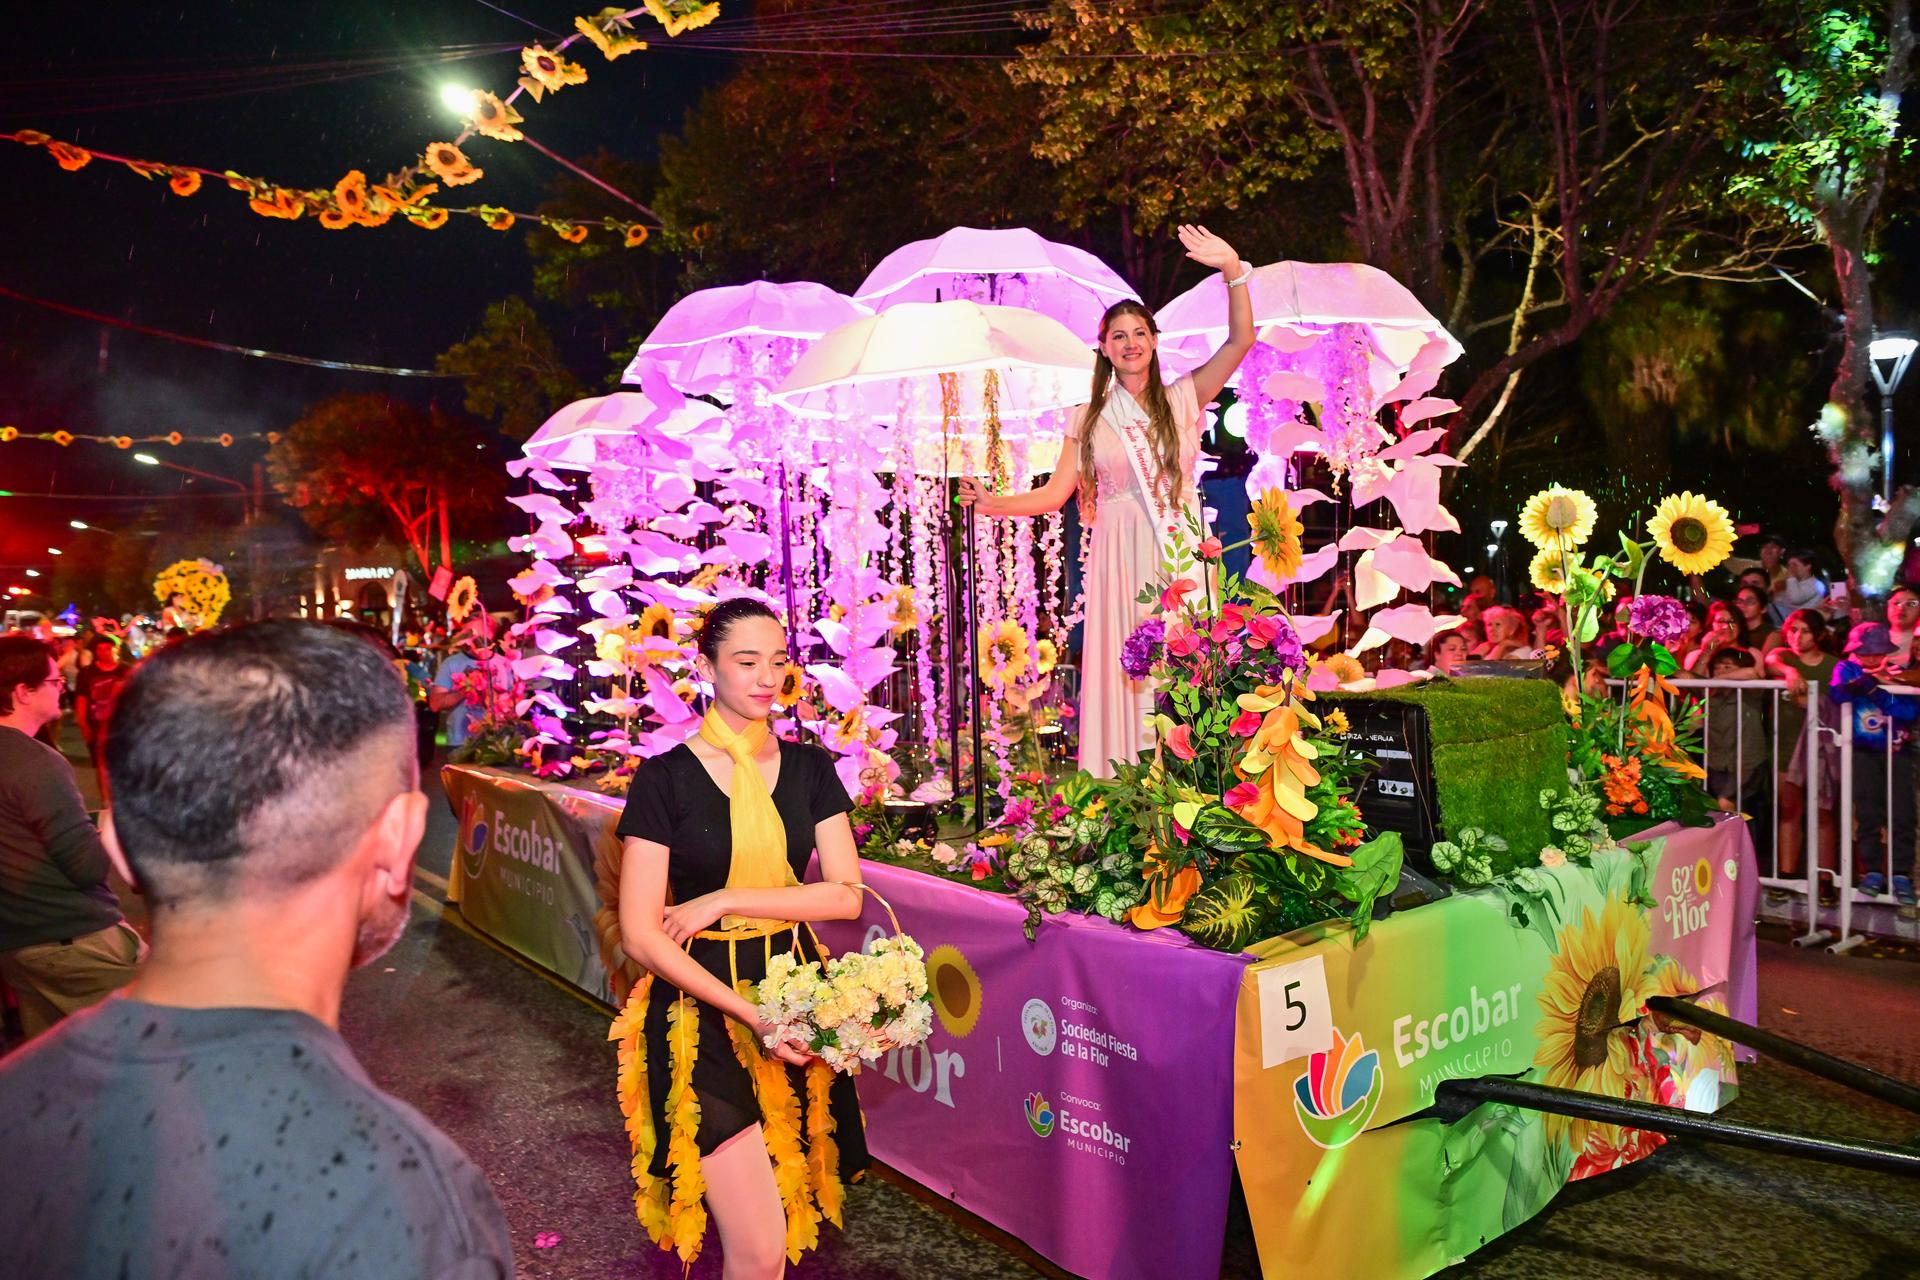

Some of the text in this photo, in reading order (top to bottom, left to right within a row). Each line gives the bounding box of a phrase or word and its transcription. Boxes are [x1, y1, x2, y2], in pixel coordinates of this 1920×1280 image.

[493, 810, 563, 875] Escobar
[499, 867, 553, 905] MUNICIPIO
[1663, 891, 1710, 939] Flor
[1061, 995, 1098, 1015] Organiza:
[1284, 981, 1307, 1031] 5
[1393, 982, 1521, 1069] Escobar
[1061, 1018, 1107, 1048] Sociedad
[1108, 1034, 1138, 1062] Fiesta
[1061, 1039, 1075, 1057] de
[1078, 1042, 1088, 1060] la
[1090, 1048, 1109, 1068] Flor
[1419, 1038, 1511, 1098] MUNICIPIO
[1060, 1091, 1102, 1111] Convoca:
[1060, 1109, 1131, 1153] Escobar
[1066, 1138, 1126, 1166] MUNICIPIO
